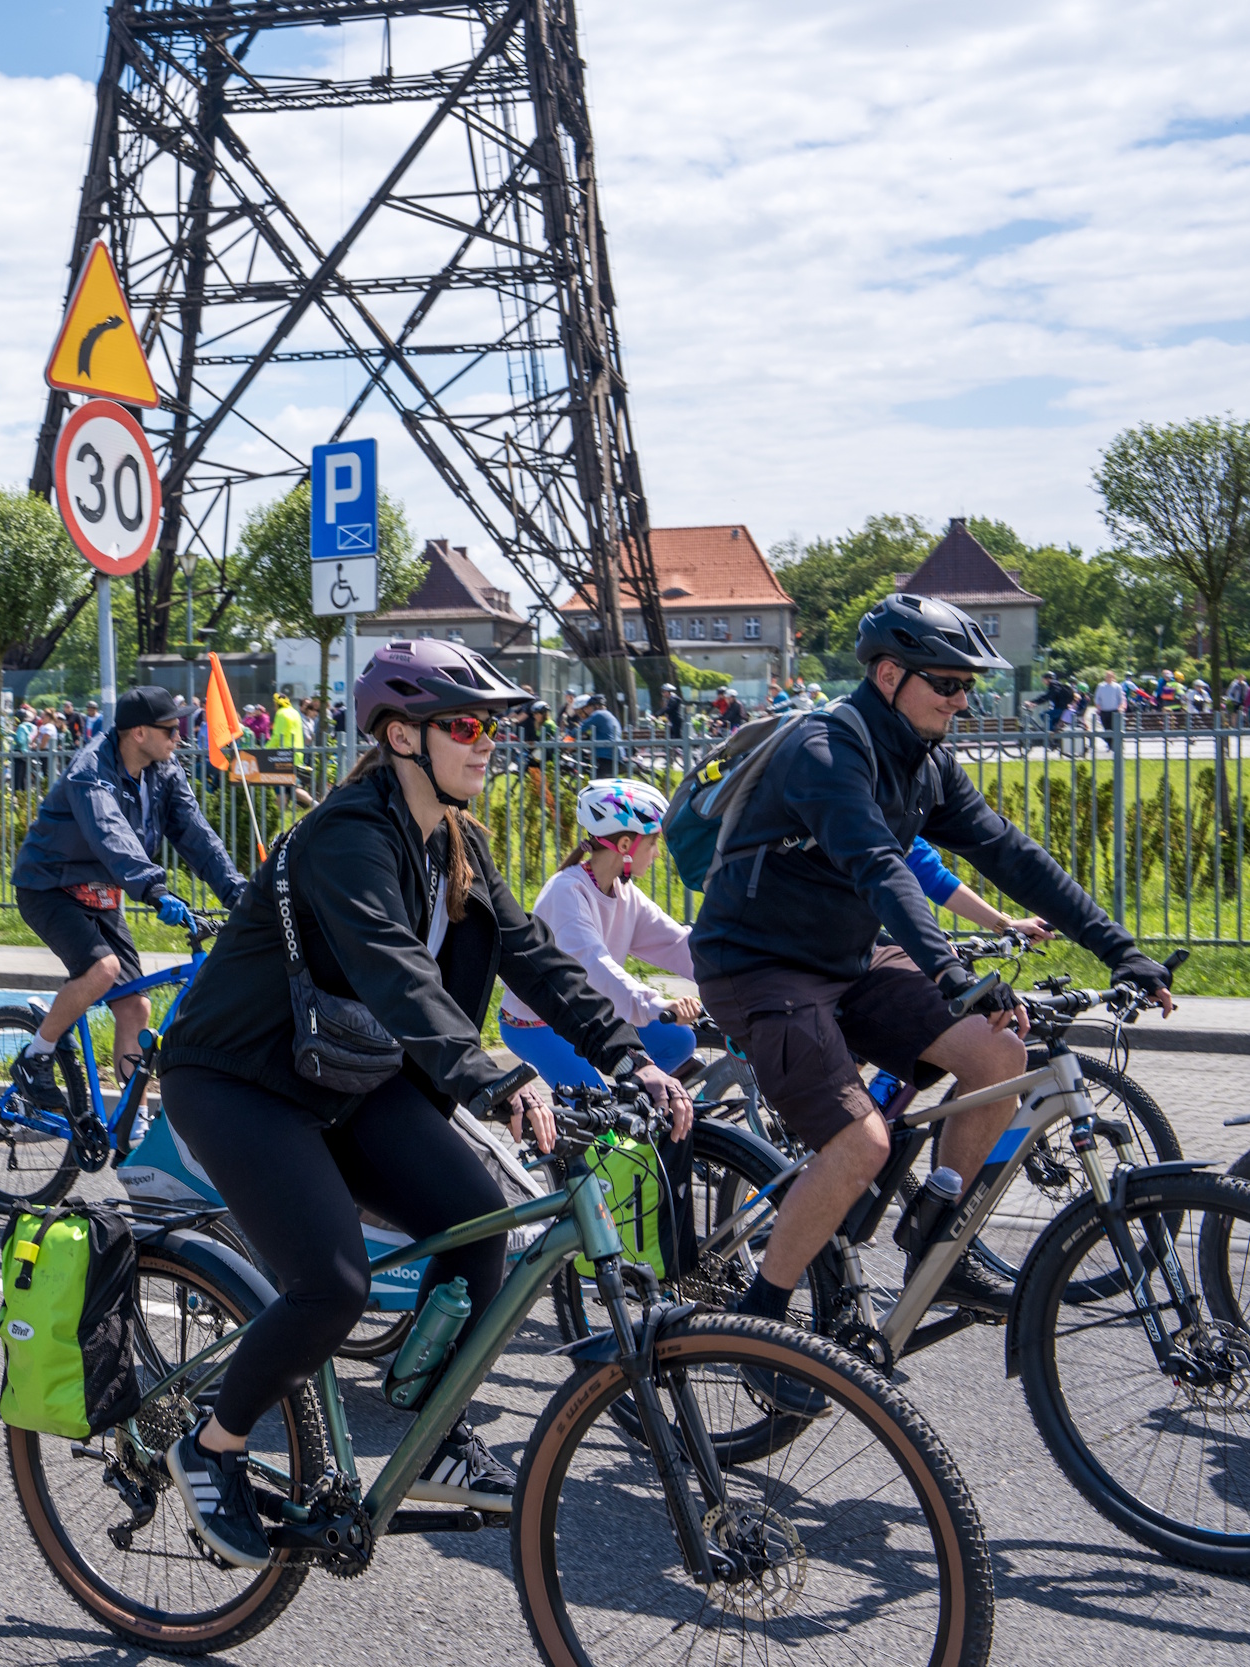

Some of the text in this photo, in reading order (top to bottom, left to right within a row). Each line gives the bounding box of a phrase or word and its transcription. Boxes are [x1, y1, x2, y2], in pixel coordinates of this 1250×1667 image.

[75, 442, 144, 533] 30
[325, 452, 363, 525] P
[950, 1181, 990, 1240] CUBE
